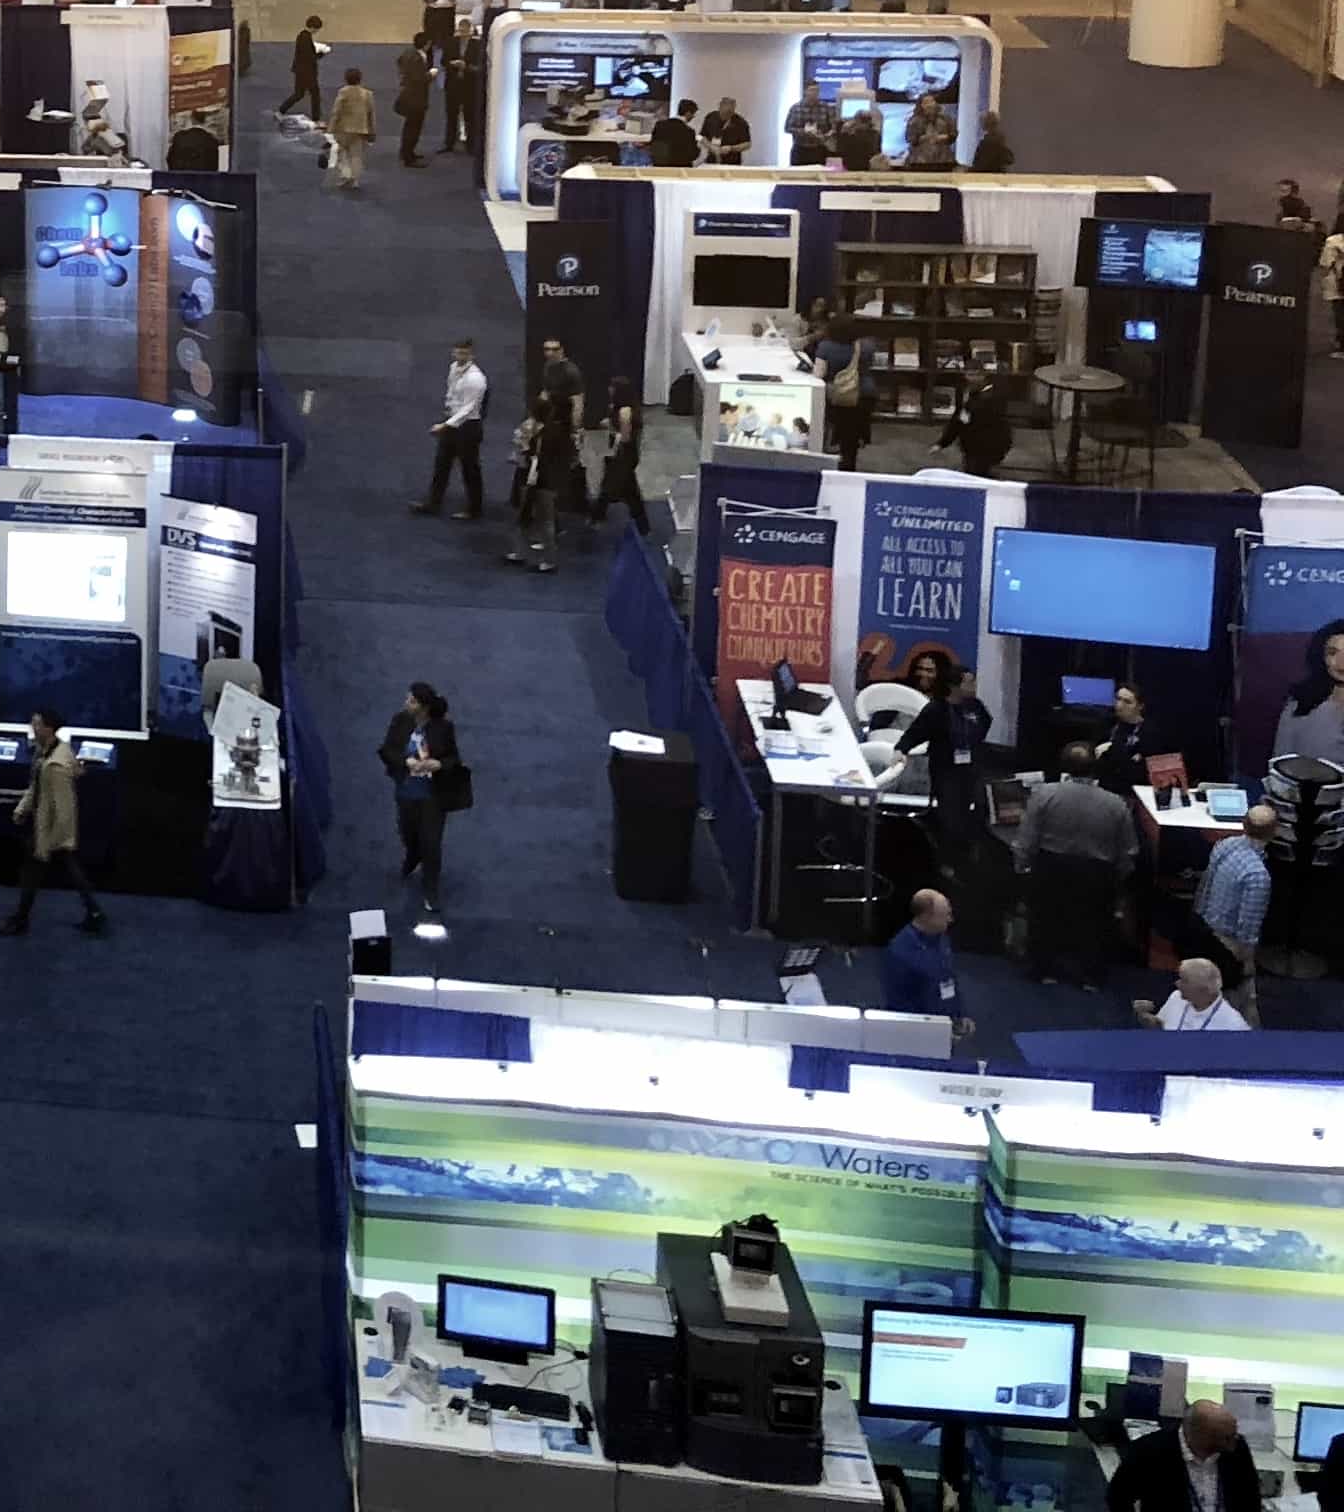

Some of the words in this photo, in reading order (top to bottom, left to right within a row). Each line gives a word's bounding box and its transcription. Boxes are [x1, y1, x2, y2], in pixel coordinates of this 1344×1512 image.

[537, 281, 600, 297] Pearson
[1223, 284, 1296, 308] Pearson
[891, 516, 975, 533] UNLIMITED
[167, 528, 198, 546] DVS
[758, 529, 826, 545] CENGAGE
[905, 537, 948, 555] ACCESS
[934, 559, 963, 578] CAN
[728, 568, 827, 606] CREATE
[876, 576, 963, 621] LEARN
[728, 601, 825, 635] CHEMISTRY
[818, 1141, 931, 1182] Waters
[770, 1170, 792, 1180] THE
[793, 1171, 841, 1187] SCIENCE
[845, 1178, 860, 1187] OF
